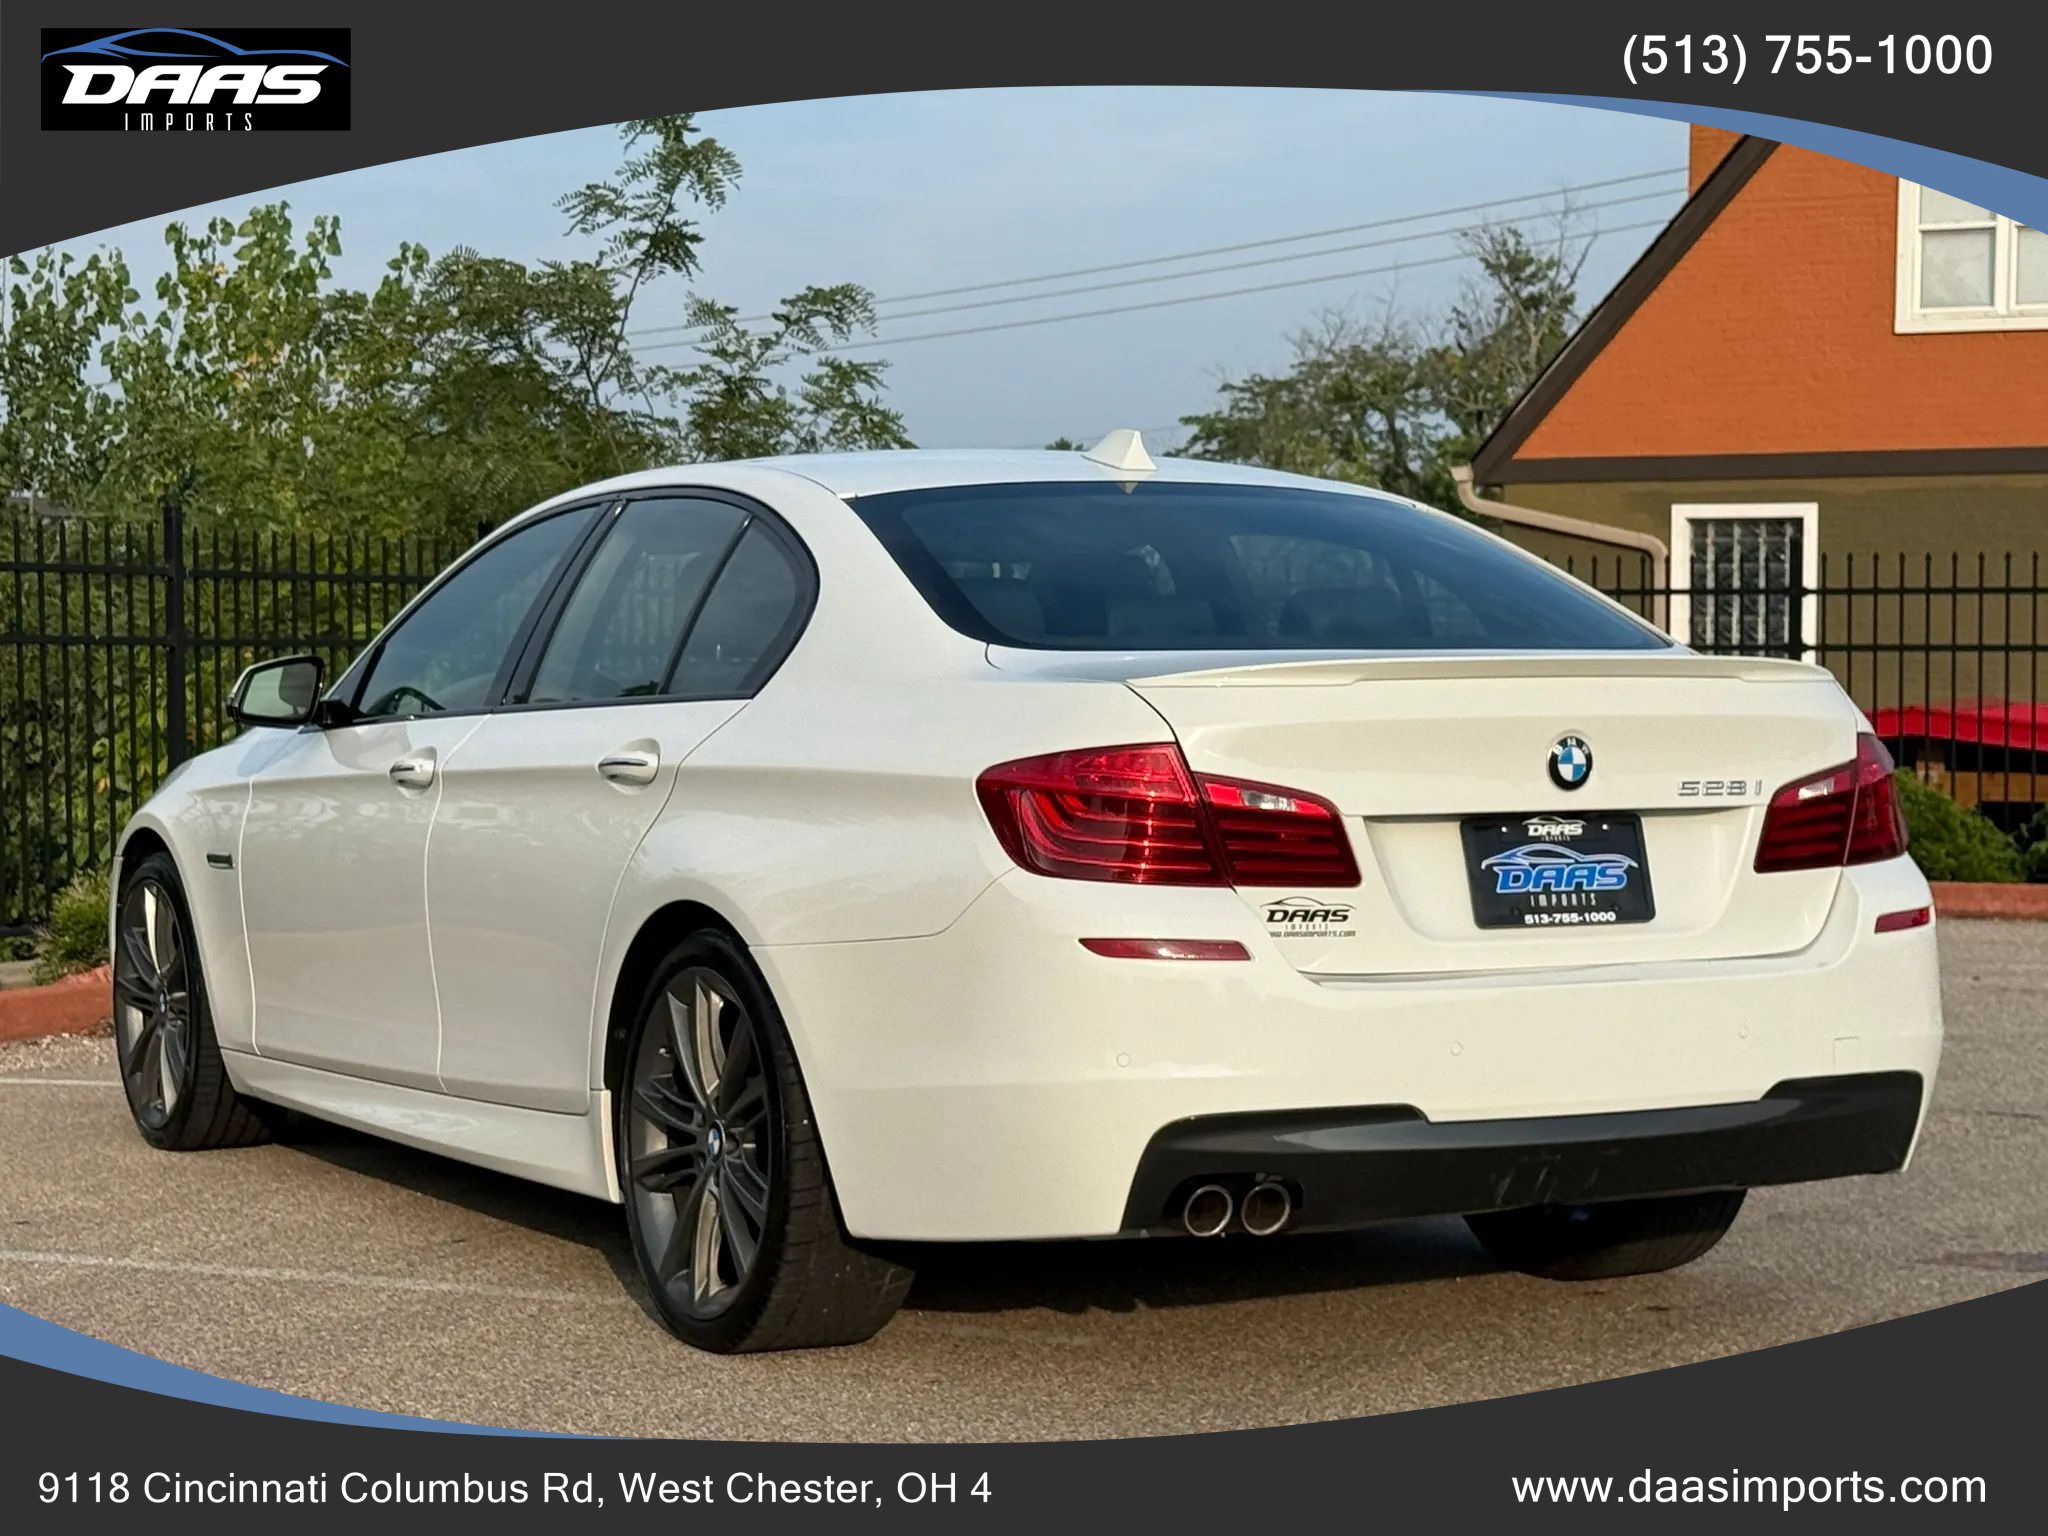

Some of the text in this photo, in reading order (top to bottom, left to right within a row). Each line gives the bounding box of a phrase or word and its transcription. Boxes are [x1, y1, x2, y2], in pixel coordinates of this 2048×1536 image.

[1527, 823, 1584, 837] DAAS
[1493, 862, 1629, 894] DAAS
[1530, 892, 1597, 908] IMPORTS
[1266, 909, 1351, 923] DAAS
[1524, 911, 1617, 925] 513-755-1000
